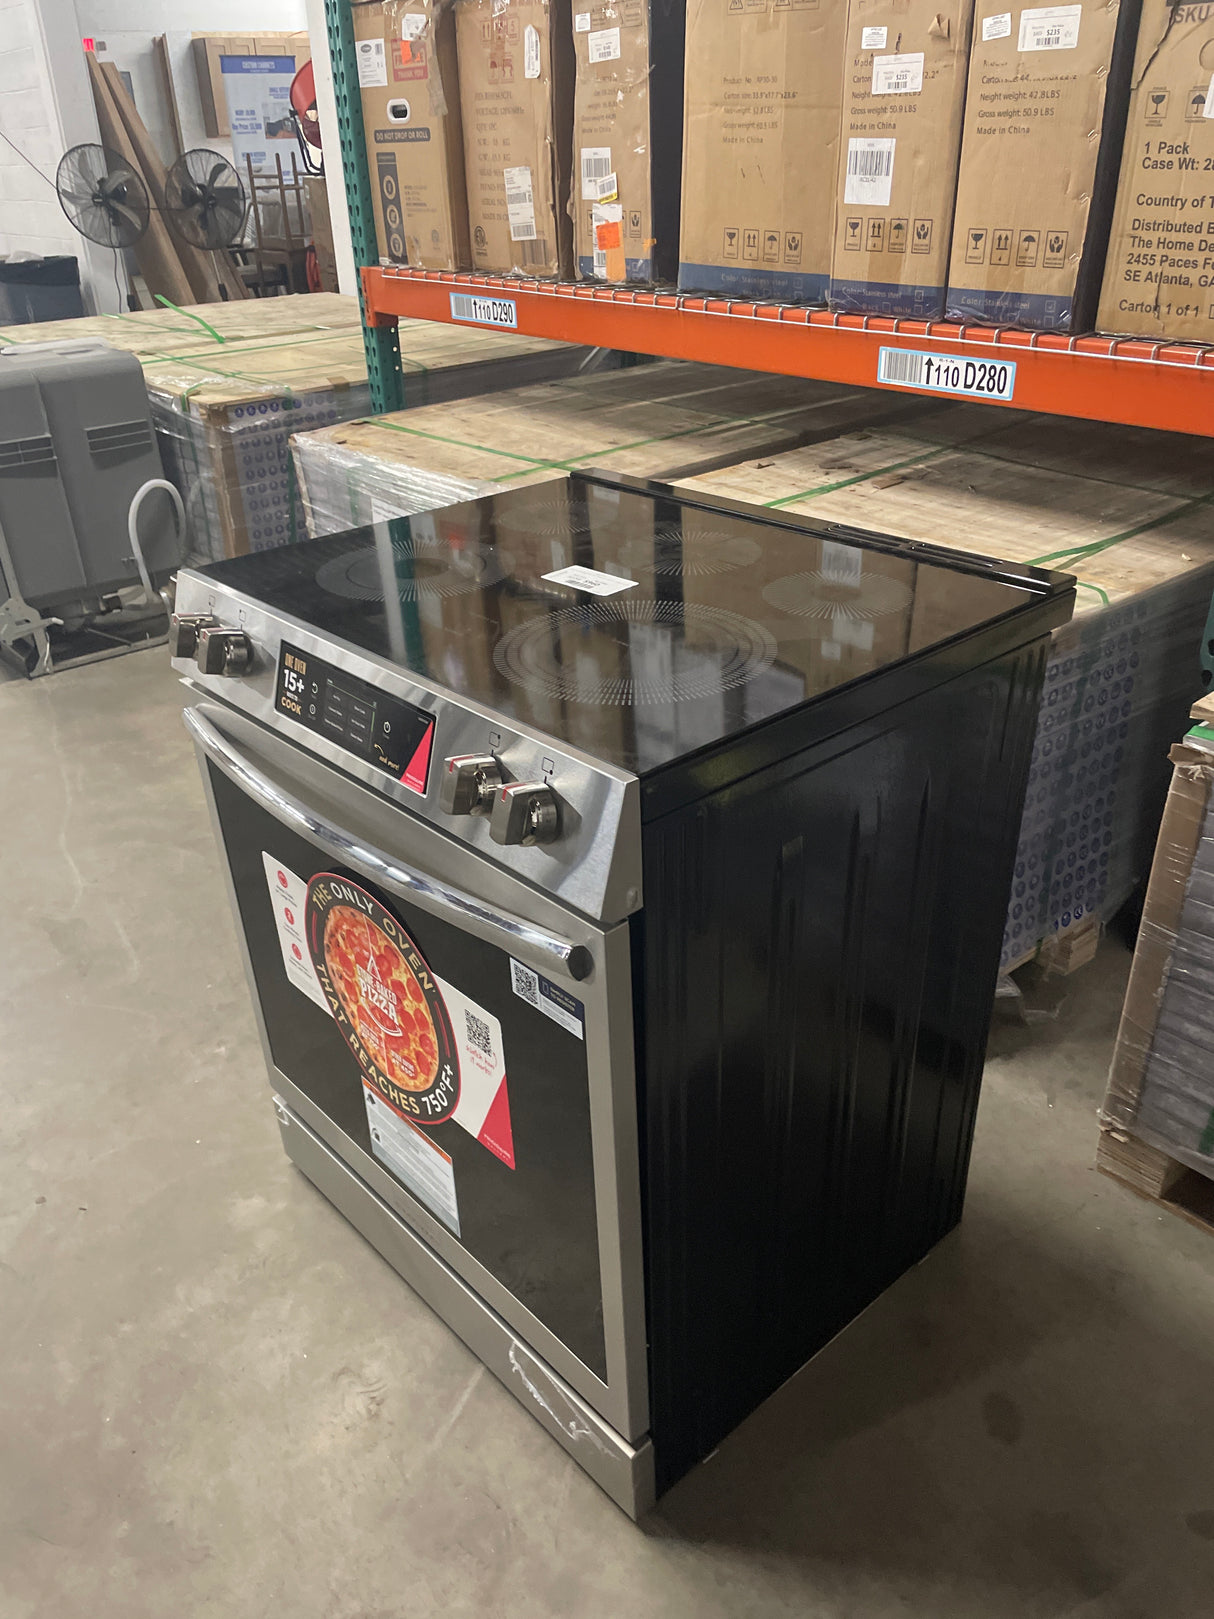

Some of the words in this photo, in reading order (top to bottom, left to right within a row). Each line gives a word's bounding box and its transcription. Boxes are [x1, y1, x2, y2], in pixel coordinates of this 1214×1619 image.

[1174, 4, 1210, 24] SKU
[868, 122, 875, 130] in
[876, 121, 896, 130] China
[976, 126, 996, 135] Made
[998, 126, 1006, 135] in
[1007, 125, 1030, 134] China
[1144, 141, 1151, 155] 1
[1158, 141, 1190, 155] Pack
[1142, 156, 1174, 170] Case
[1177, 157, 1200, 171] Wt:
[1136, 193, 1187, 211] Country
[1191, 195, 1206, 209] of
[1131, 218, 1204, 234] Distributed
[1129, 235, 1153, 249] The
[1156, 236, 1195, 251] Home
[1126, 252, 1156, 267] 2455
[1160, 254, 1199, 270] Paces
[1123, 269, 1142, 282] SE
[1144, 270, 1194, 289] Atlanta,
[478, 304, 491, 320] 110
[491, 301, 513, 323] D290
[1165, 302, 1172, 315] 1
[1175, 303, 1191, 316] of
[1193, 305, 1200, 318] 1
[934, 364, 960, 388] 110
[963, 361, 1008, 394] D280
[283, 668, 305, 693] 15+
[281, 696, 302, 715] COOK
[312, 883, 333, 911] THE
[330, 882, 374, 915] ONLY
[359, 977, 399, 1026] PIZZA
[316, 963, 348, 1025] THAT
[349, 1033, 420, 1115] REACHES
